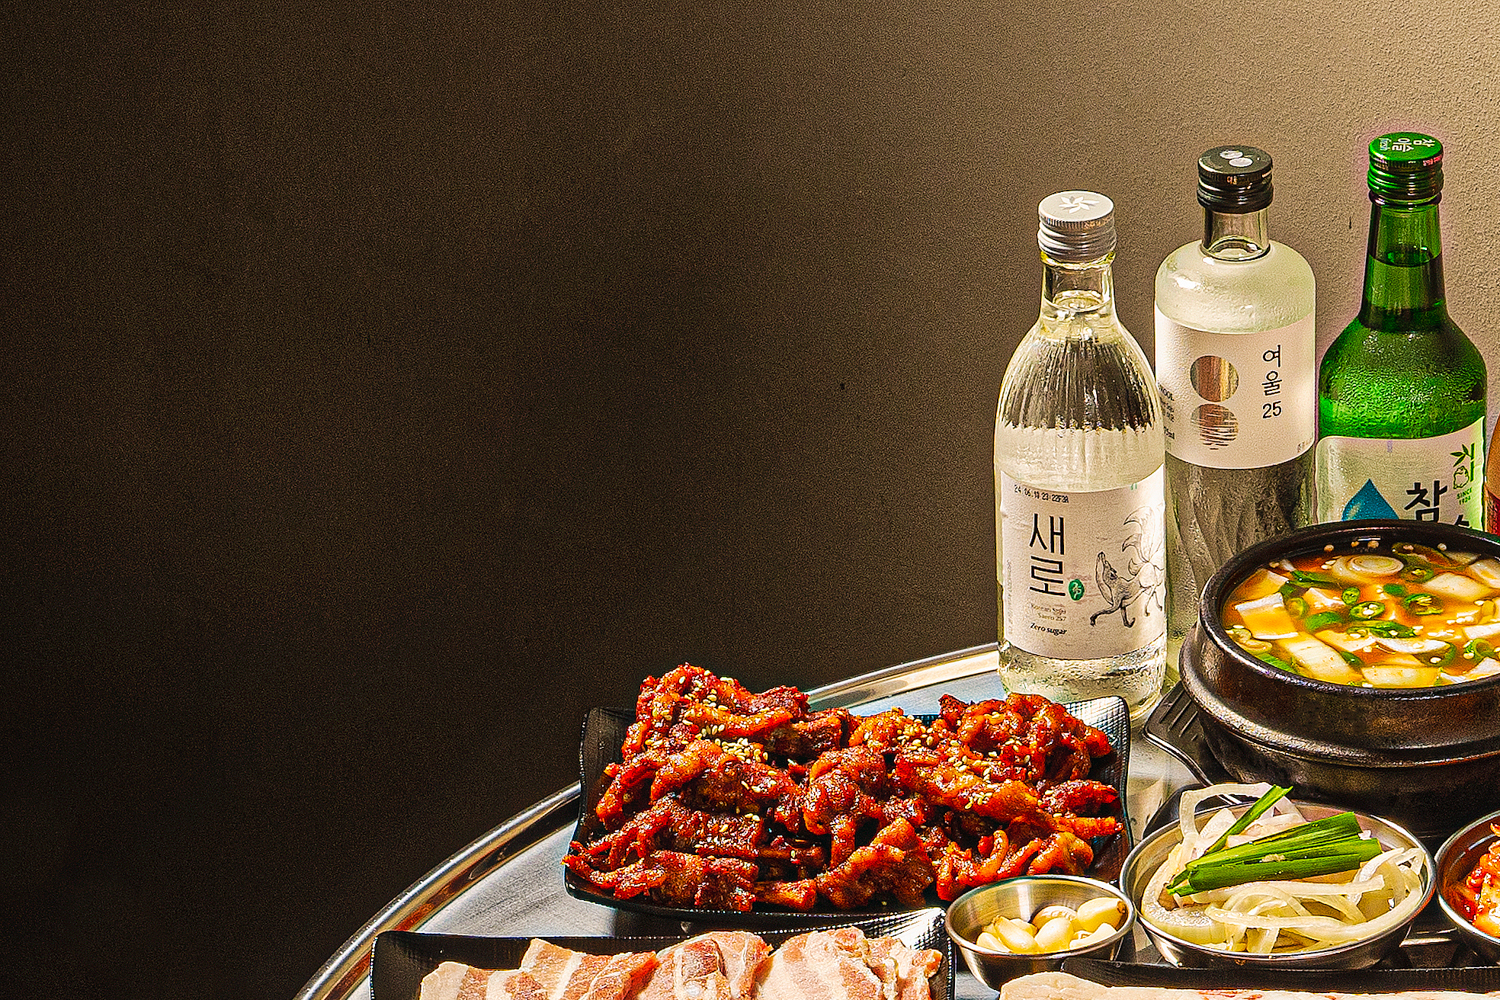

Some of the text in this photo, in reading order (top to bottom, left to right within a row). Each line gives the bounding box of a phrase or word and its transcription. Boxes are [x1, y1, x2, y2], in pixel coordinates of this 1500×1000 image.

[1262, 344, 1283, 419] 여울 25
[1456, 487, 1473, 500] SINCE
[1029, 513, 1066, 597] 새로
[1030, 622, 1068, 636] Zero sugar
